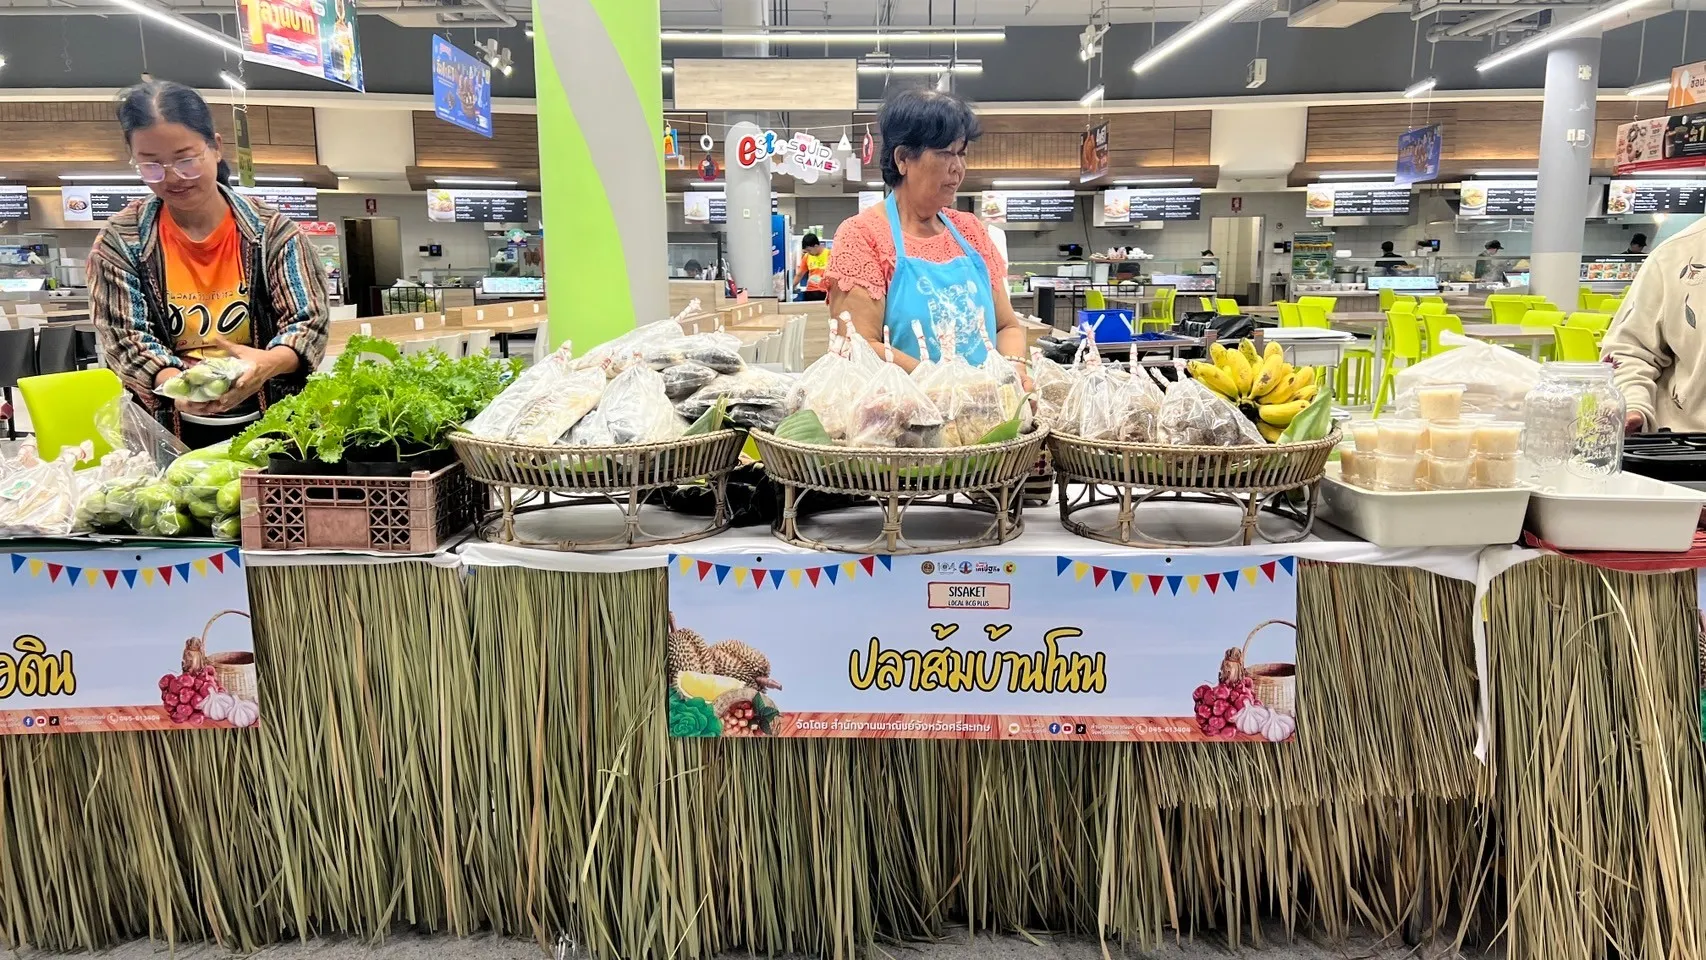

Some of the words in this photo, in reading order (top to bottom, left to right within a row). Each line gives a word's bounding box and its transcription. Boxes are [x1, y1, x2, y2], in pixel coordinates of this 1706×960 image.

[738, 132, 775, 167] est
[787, 140, 831, 158] SQUID
[948, 586, 986, 597] SISAKET
[849, 623, 1106, 693] ปลาส้มบ้านโนน
[796, 719, 828, 730] จัดโดย
